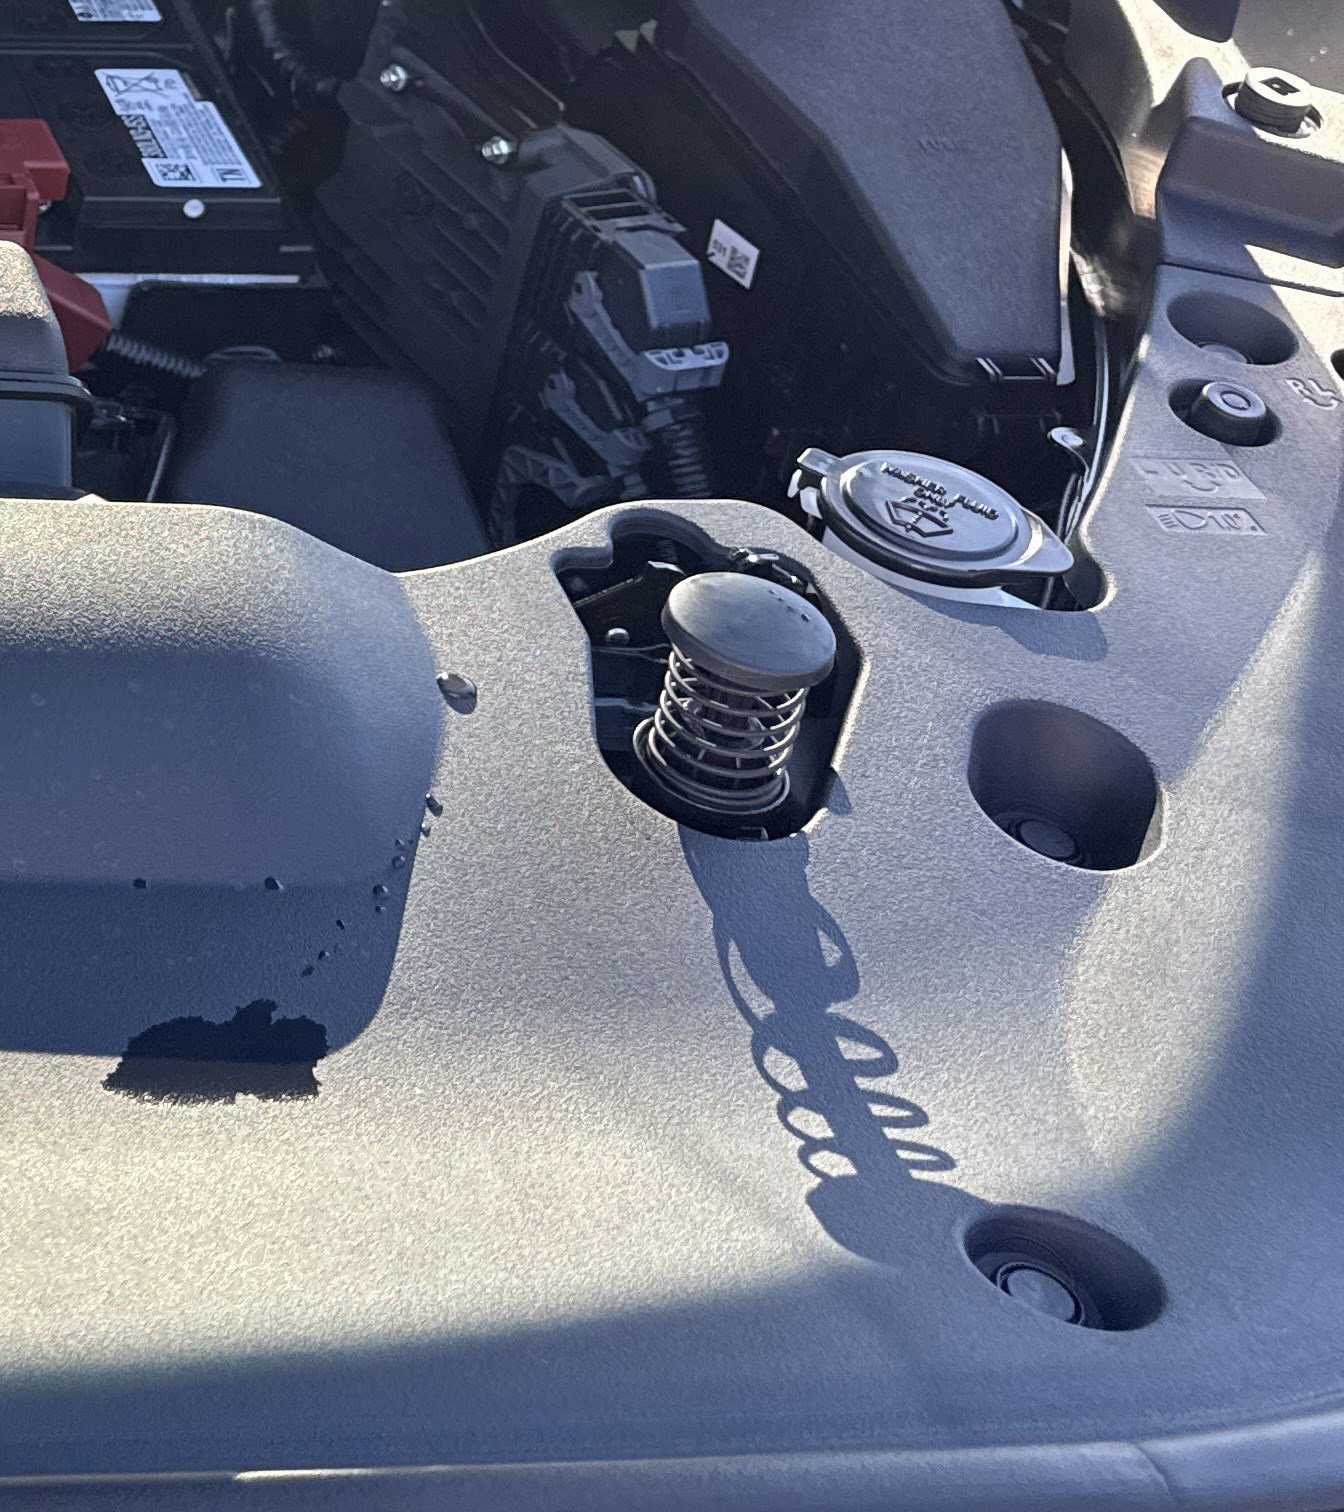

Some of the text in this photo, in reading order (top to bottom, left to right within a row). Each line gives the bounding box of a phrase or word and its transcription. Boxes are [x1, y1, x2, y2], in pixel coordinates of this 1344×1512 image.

[880, 461, 1000, 521] WASHER FLUID
[913, 487, 954, 509] ONLY
